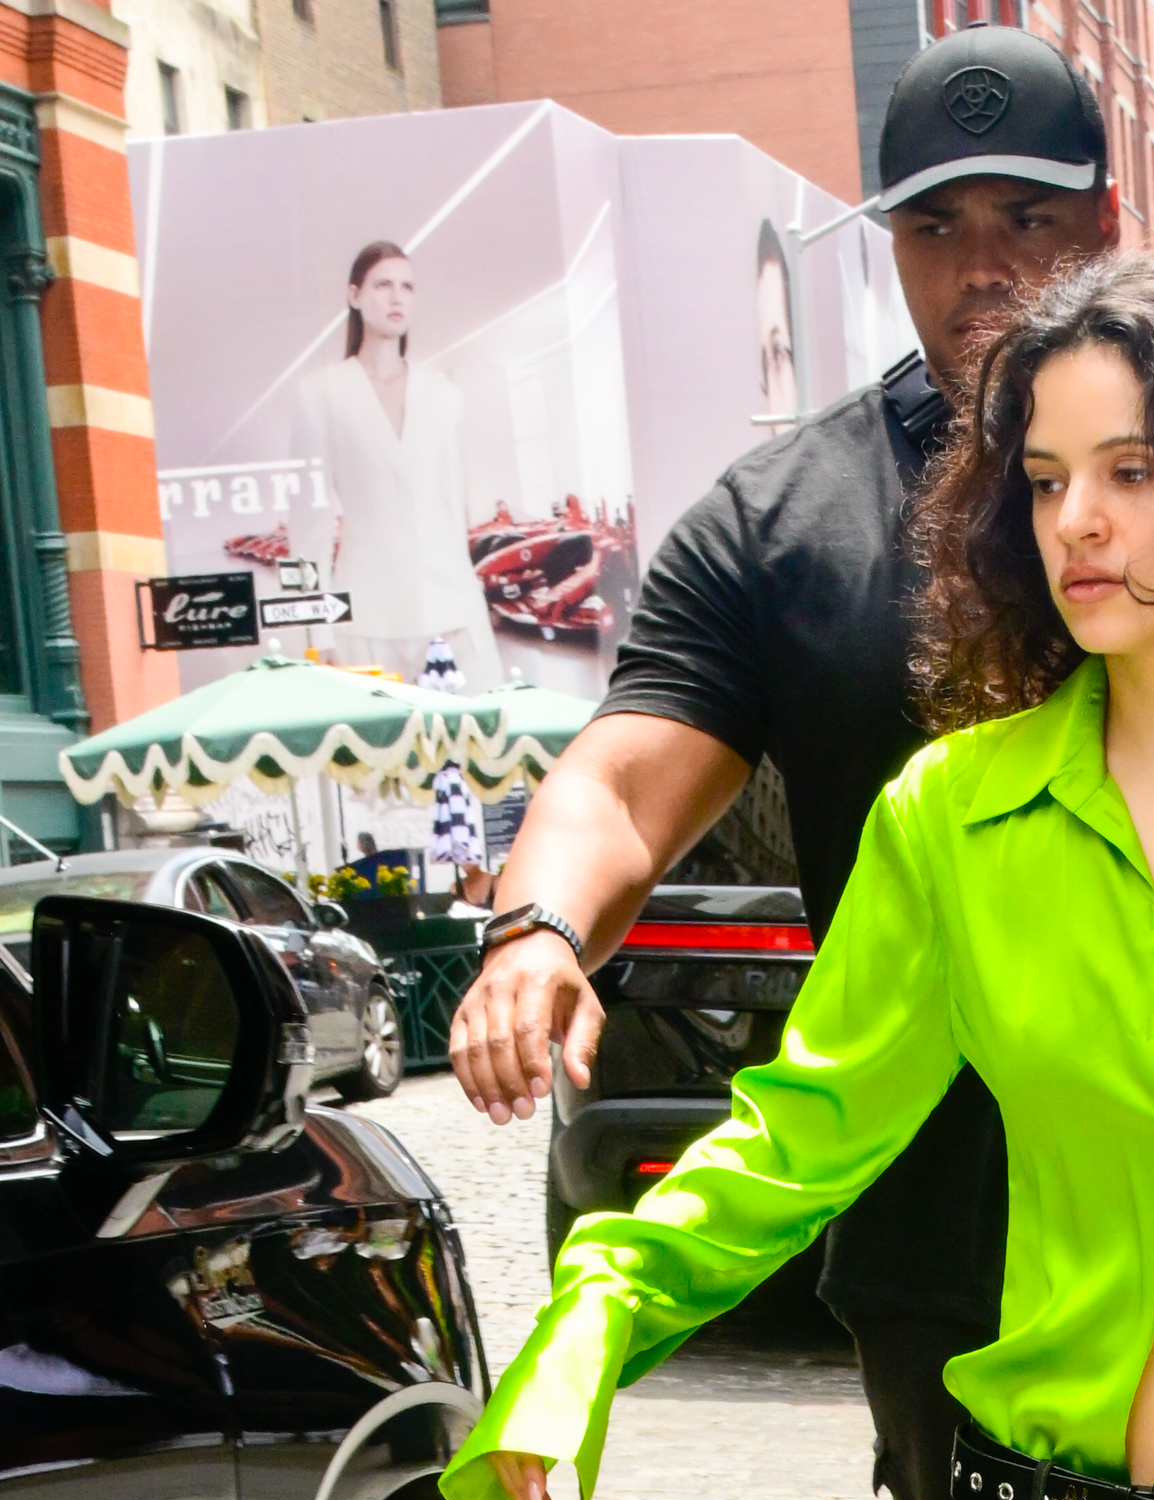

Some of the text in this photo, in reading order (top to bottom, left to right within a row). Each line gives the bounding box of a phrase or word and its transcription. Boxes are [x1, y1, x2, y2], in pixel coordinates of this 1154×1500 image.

[157, 457, 330, 521] rrari
[272, 602, 338, 620] ONE WAY
